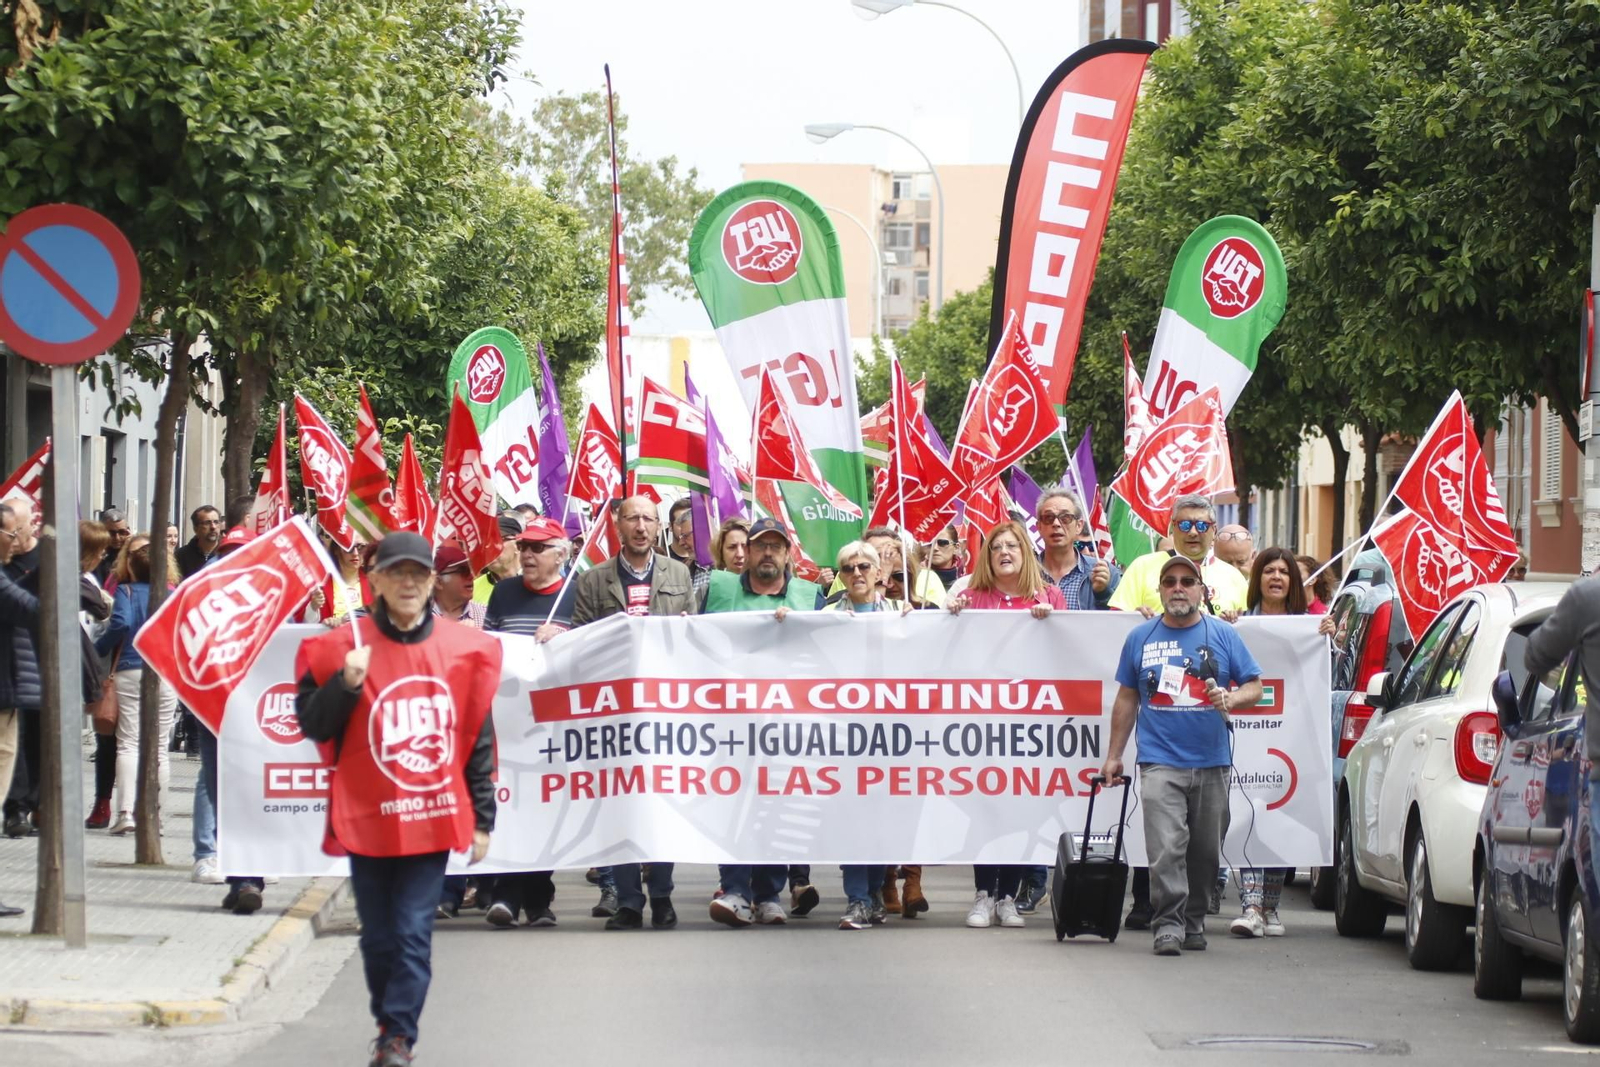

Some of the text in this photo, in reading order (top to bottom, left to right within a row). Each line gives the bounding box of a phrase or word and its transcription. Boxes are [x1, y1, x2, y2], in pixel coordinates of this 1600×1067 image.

[1022, 91, 1117, 368] CCOO
[1213, 244, 1261, 294] UGT
[1150, 360, 1199, 420] UG
[302, 432, 343, 490] UGT
[586, 435, 622, 494] UGT
[1140, 430, 1206, 489] UGT
[443, 497, 479, 552] ALUCIA
[180, 574, 268, 657] UGT
[1169, 640, 1178, 649] SE
[263, 693, 296, 718] UG
[383, 694, 450, 745] UGT
[568, 678, 1064, 715] LA LUCHA CONTINÚA
[269, 768, 329, 790] CCO
[541, 765, 742, 803] PRIMERO
[757, 765, 842, 796] LAS
[857, 765, 1103, 797] PERSONAS
[1230, 771, 1283, 784] ndalucía
[263, 802, 328, 815] campo de
[381, 796, 424, 816] mano
